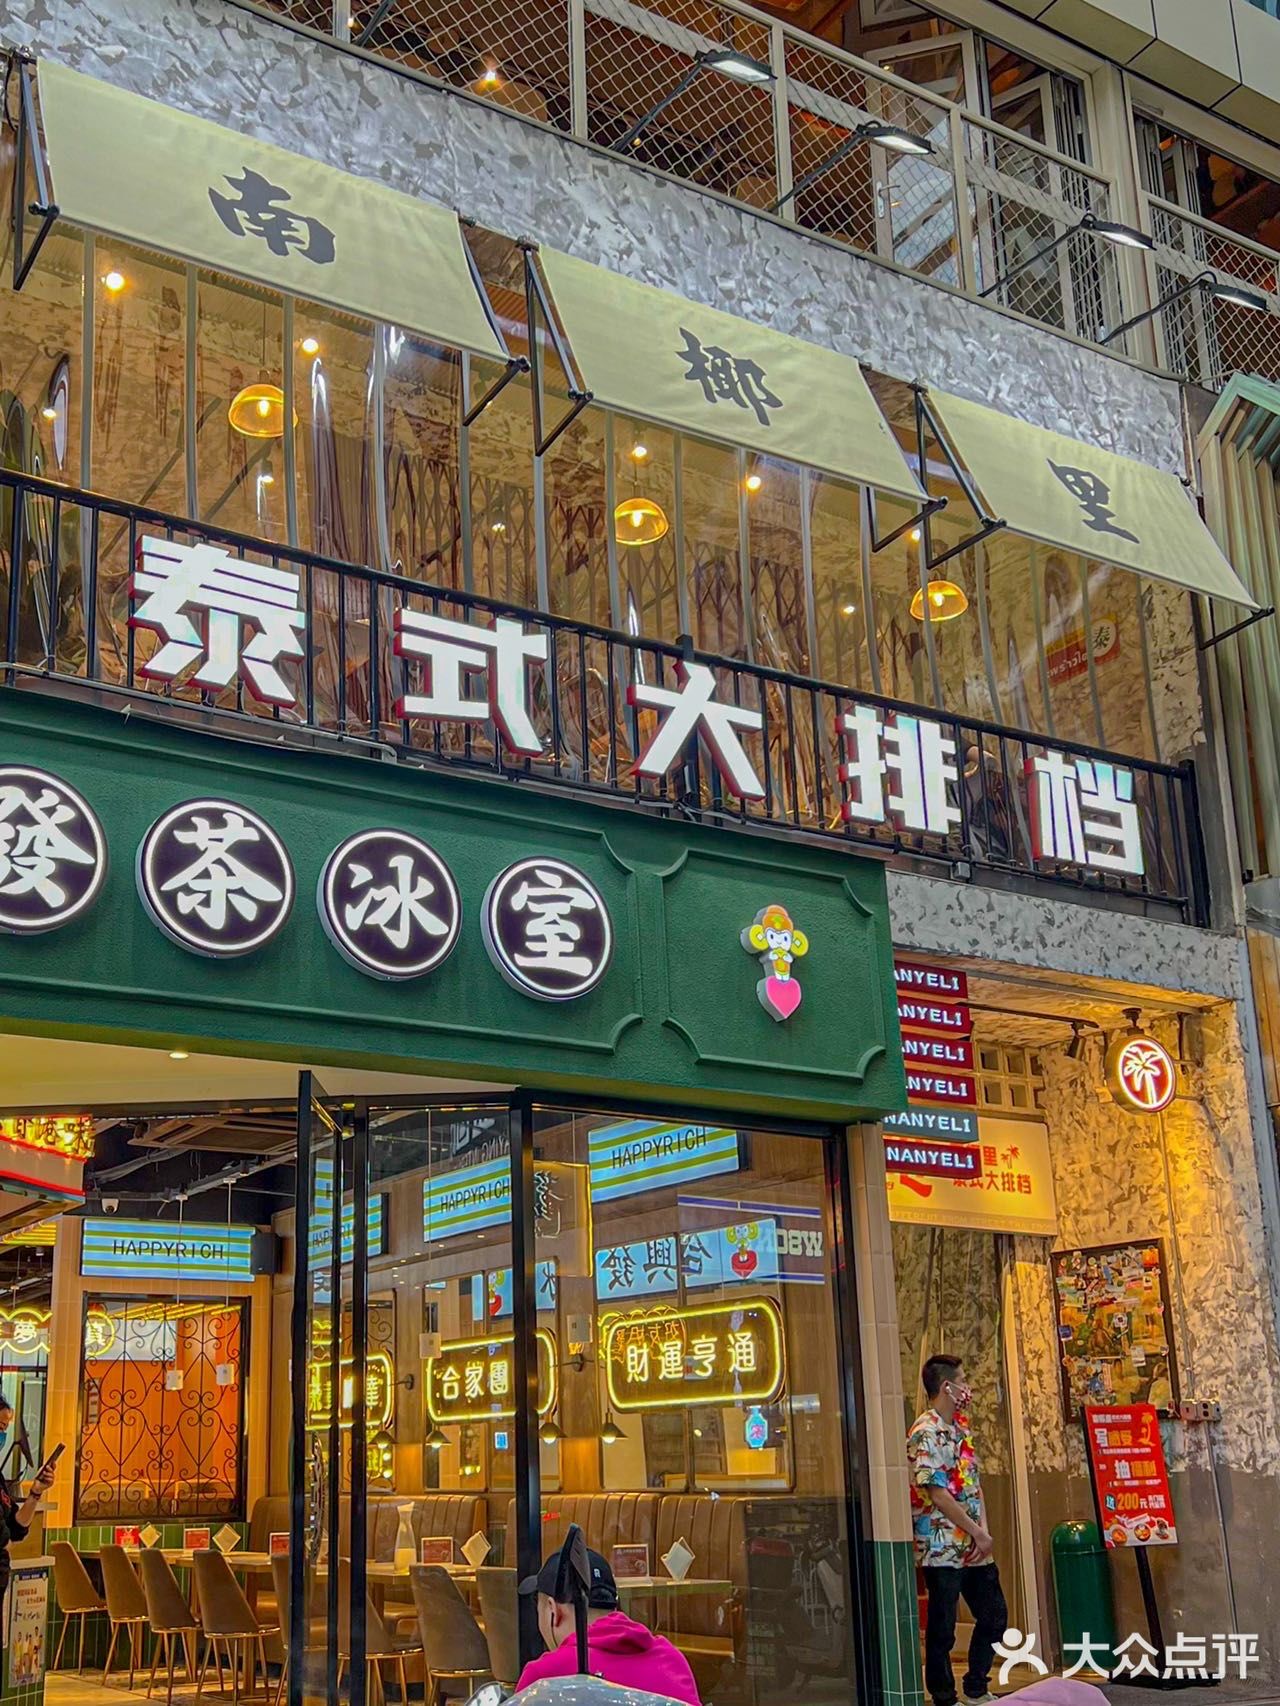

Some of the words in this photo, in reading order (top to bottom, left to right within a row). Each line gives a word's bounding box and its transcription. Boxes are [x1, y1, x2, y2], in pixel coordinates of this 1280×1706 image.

[208, 166, 336, 265] 南
[1046, 457, 1141, 545] 里
[126, 535, 1146, 876] 泰式大排档
[902, 1040, 966, 1062] NYELI
[905, 1074, 969, 1097] NYELI
[885, 1111, 971, 1133] NANYELI
[612, 1125, 707, 1169] HAPPYRICH
[886, 1145, 975, 1170] NANYELI
[440, 1179, 510, 1214] HAPPYRICH
[112, 1239, 224, 1260] HAPPYRICH
[625, 1331, 757, 1384] 財運亨通
[441, 1359, 509, 1399] 合家團
